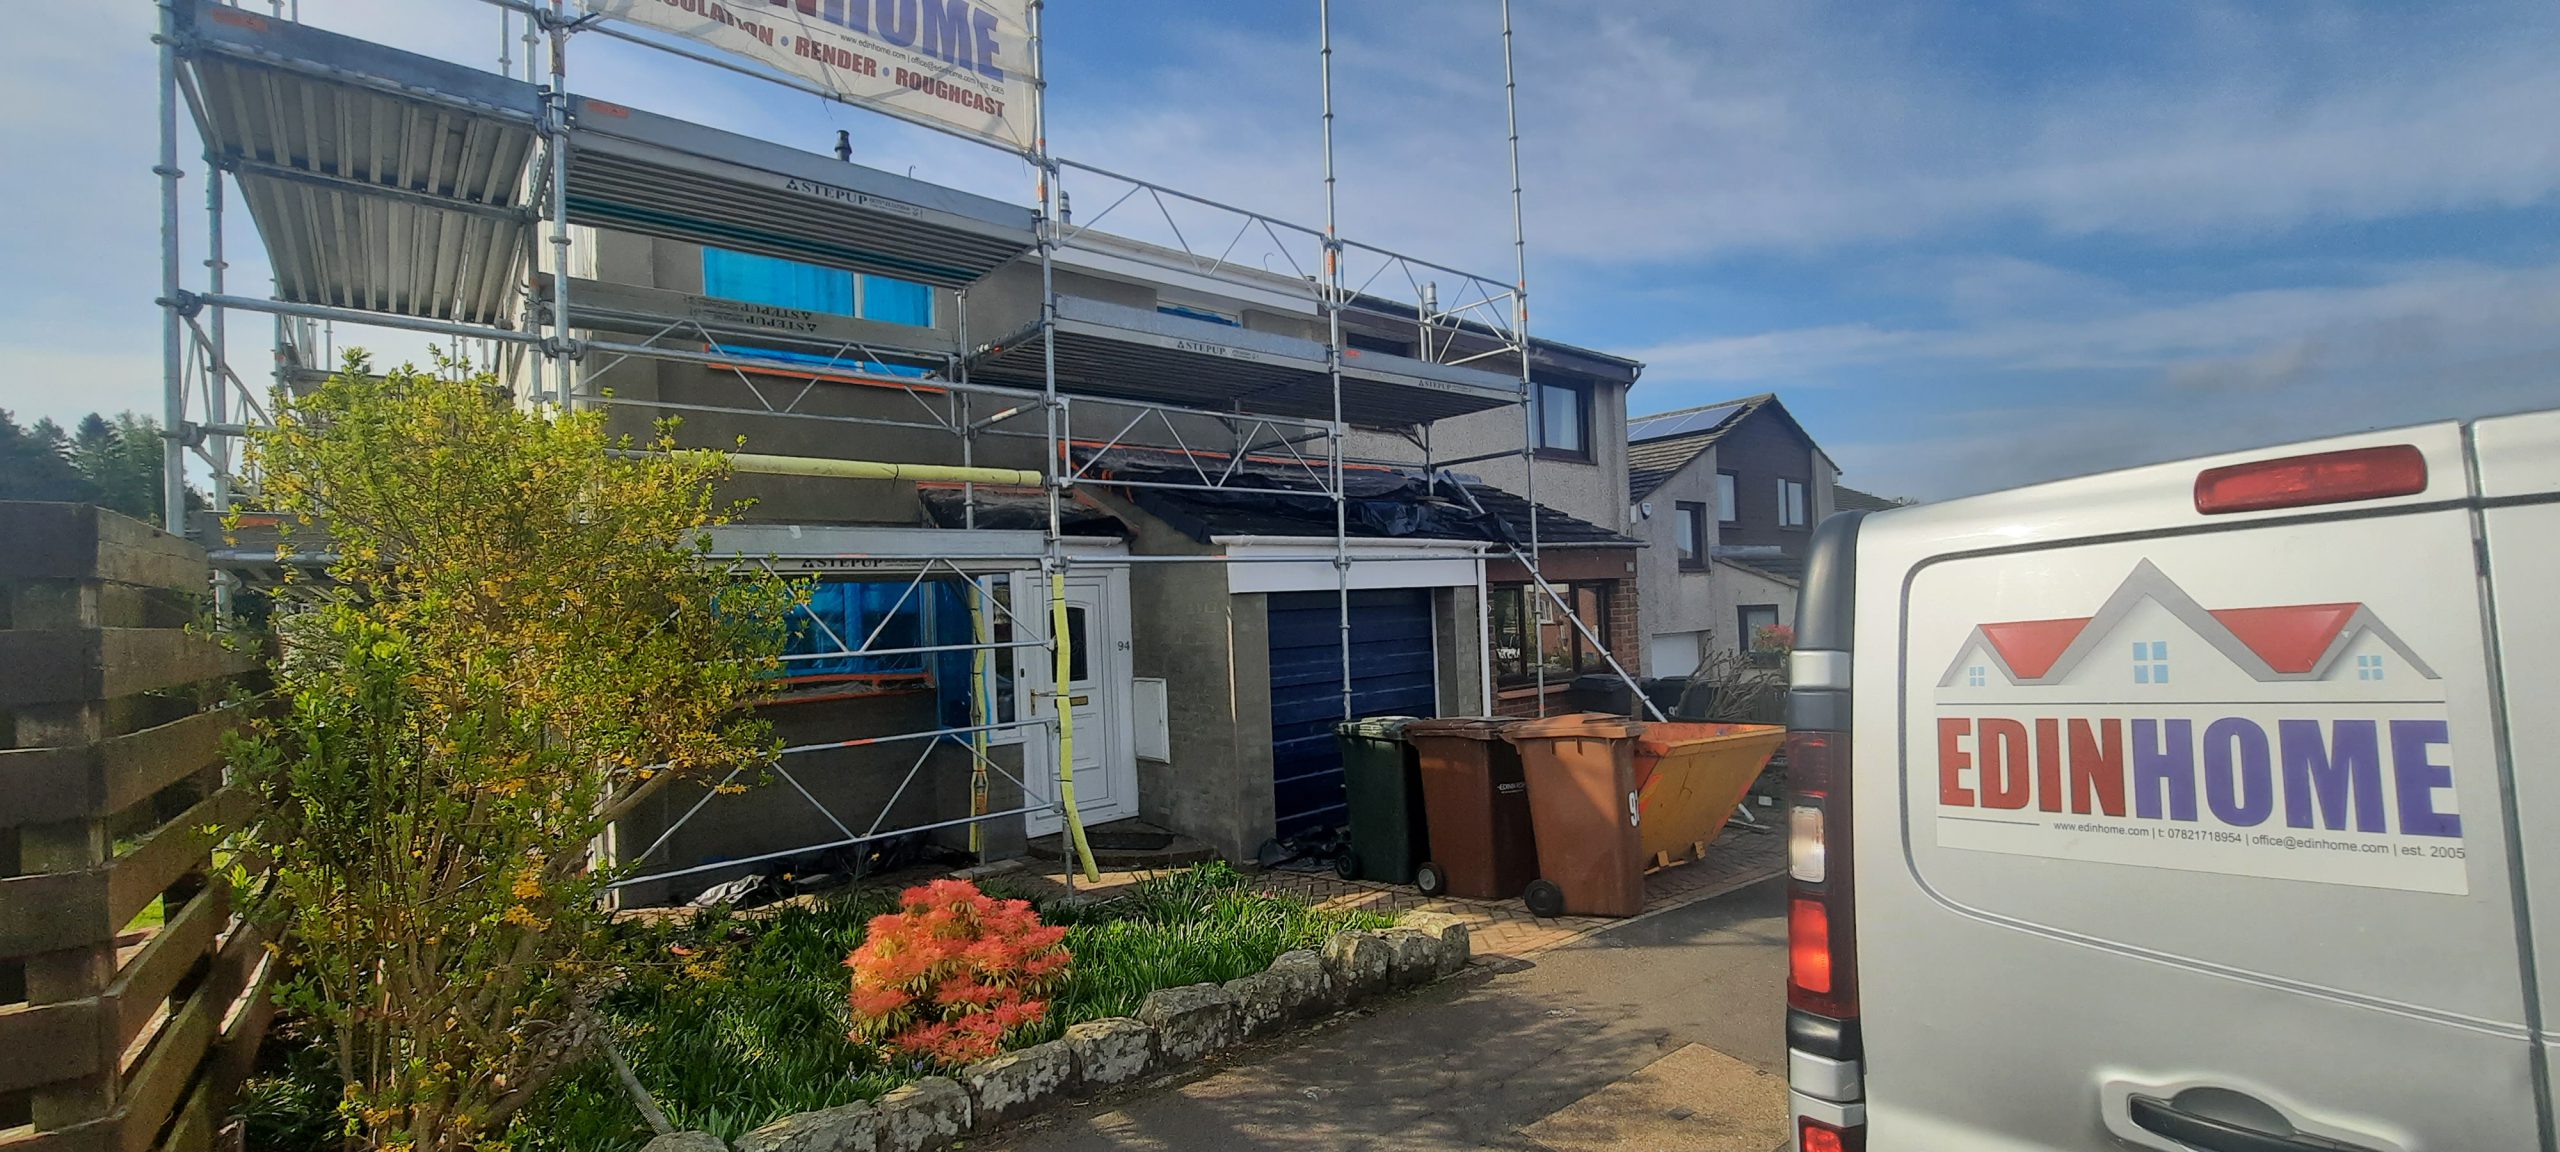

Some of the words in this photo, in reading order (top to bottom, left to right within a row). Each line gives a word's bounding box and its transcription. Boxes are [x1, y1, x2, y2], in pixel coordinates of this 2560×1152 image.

[840, 34, 906, 60] www.edinhome.com
[795, 36, 876, 77] RENDER
[895, 67, 1005, 118] ROUGHCAST
[801, 182, 868, 205] STEPUP
[746, 316, 805, 331] STEPUP
[1185, 342, 1226, 355] STEPUP
[817, 558, 882, 568] STEPUP
[1117, 640, 1130, 651] 94
[1936, 716, 2463, 839] EDINHOME
[2053, 822, 2149, 837] www.edinhome.com
[2168, 828, 2242, 843] 07821718954
[2252, 834, 2389, 854] office@edinhome.com
[2401, 845, 2425, 857] est.
[2430, 846, 2466, 859] 2005
